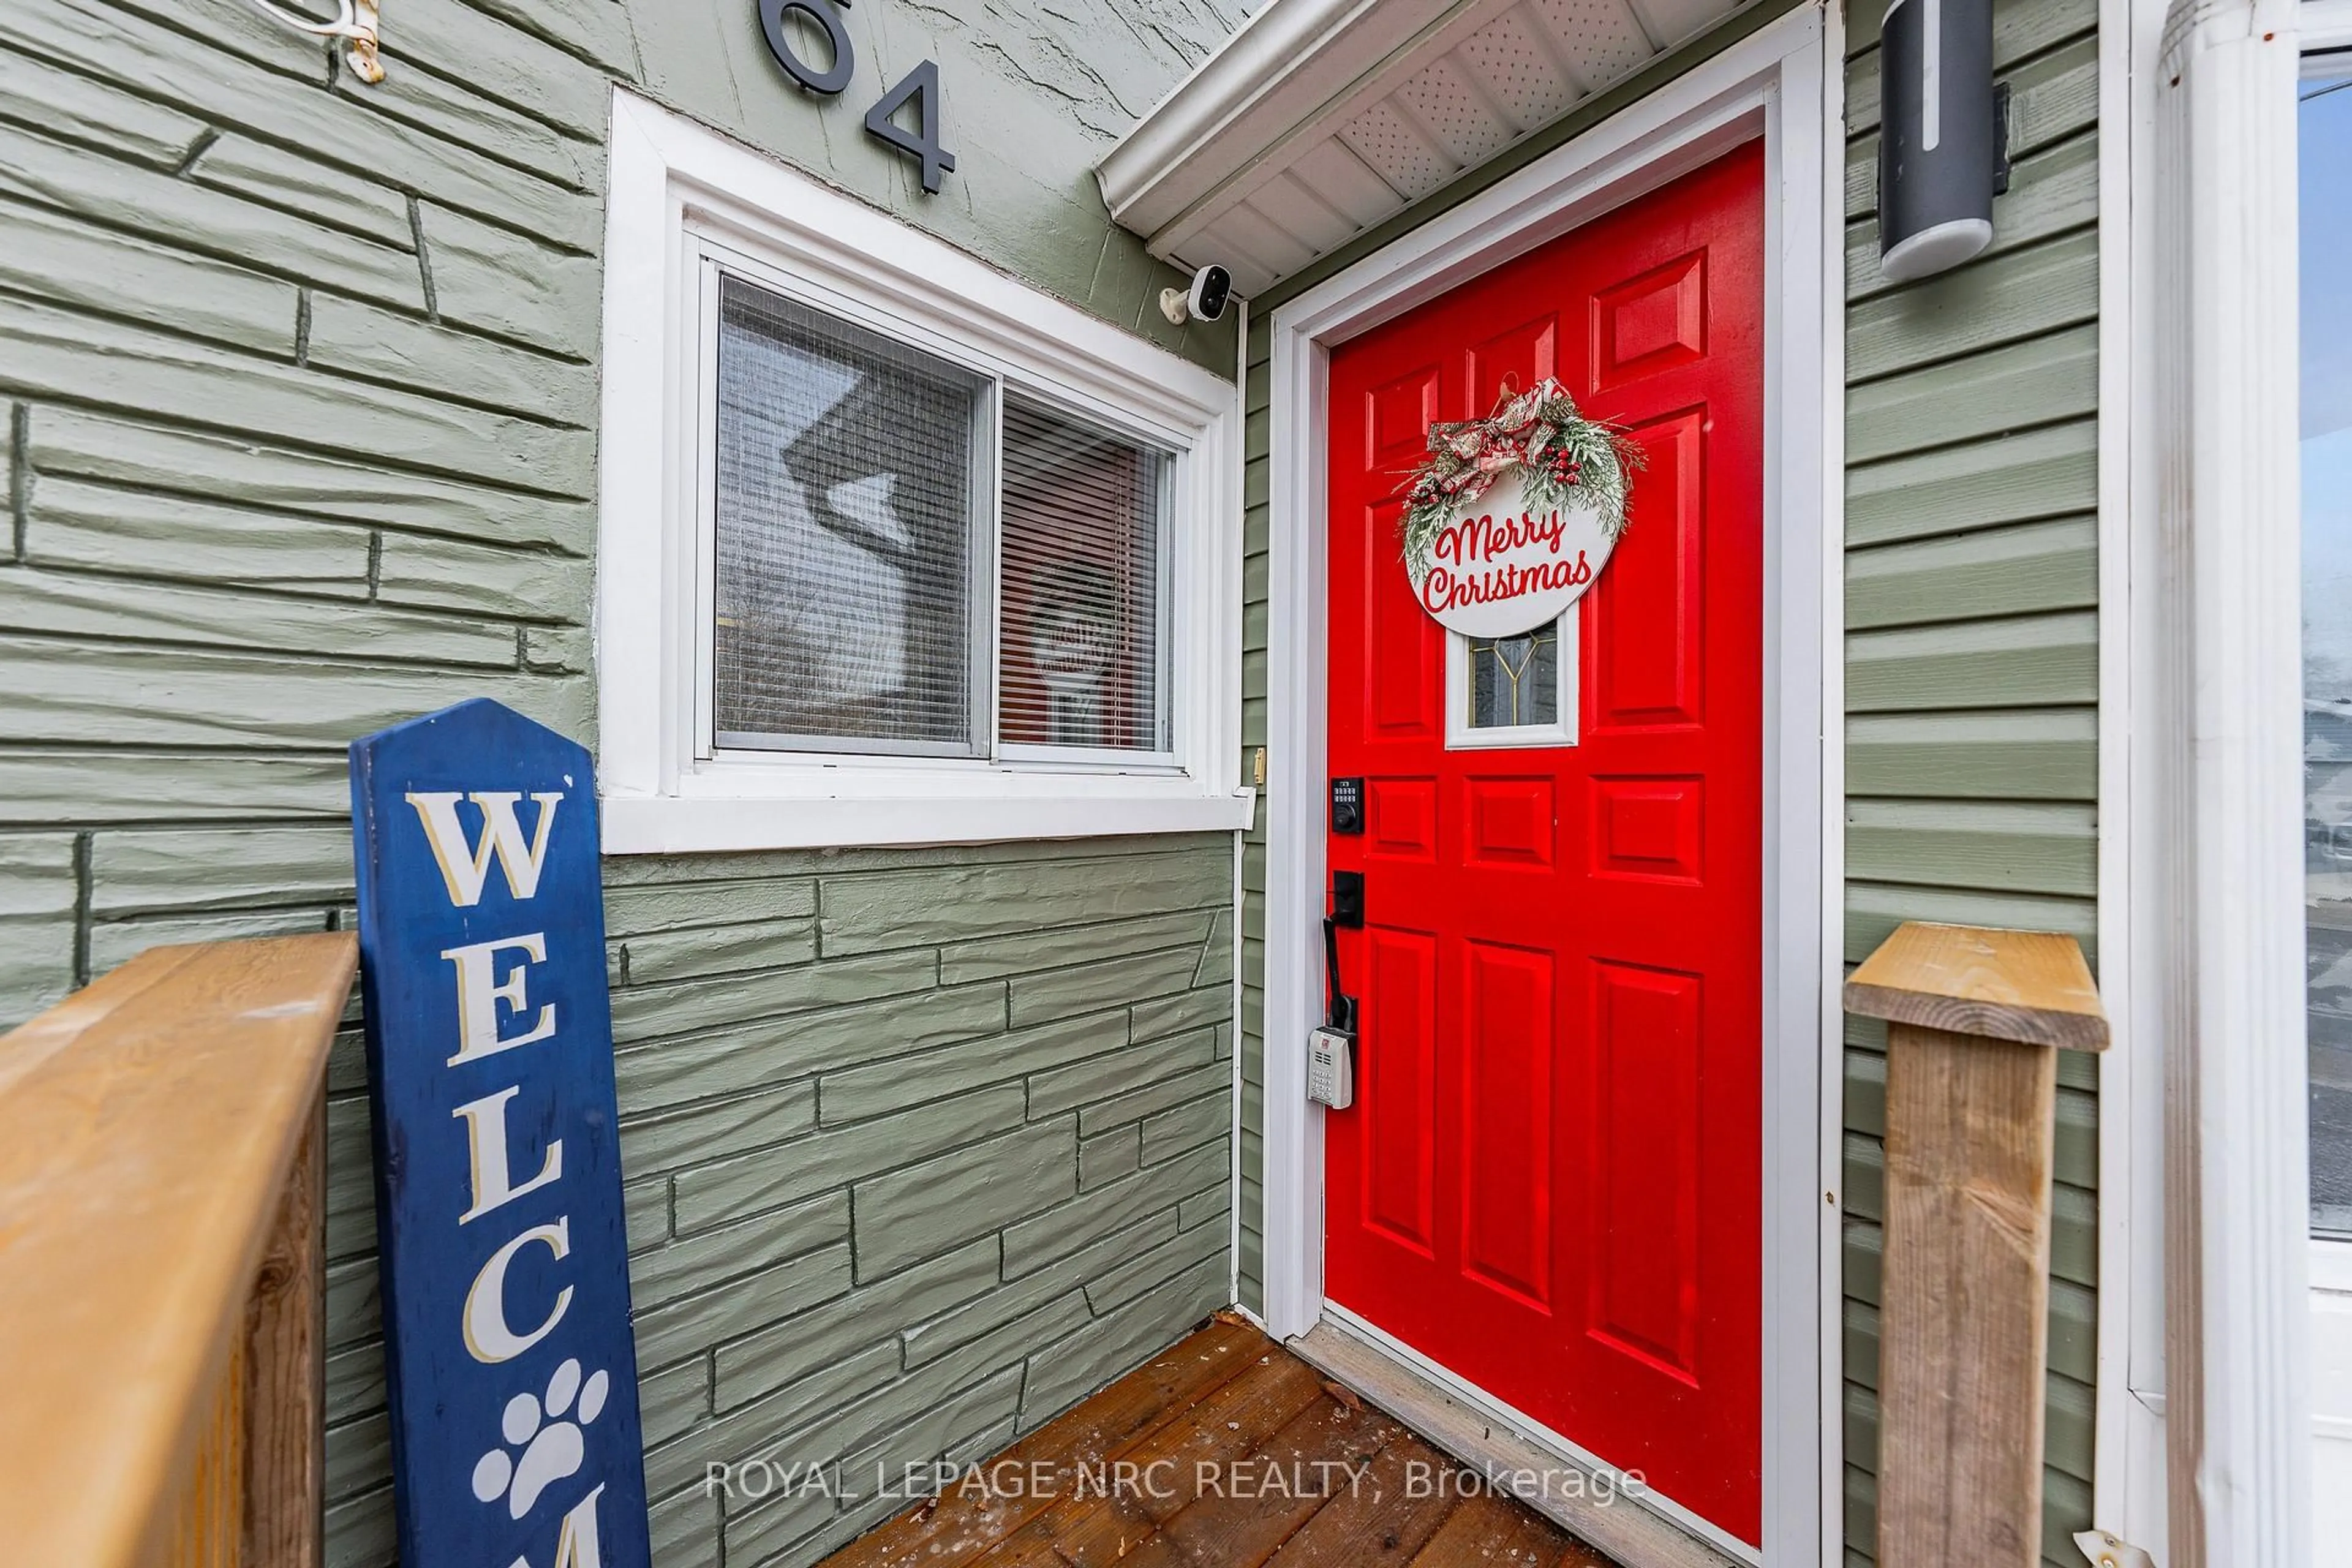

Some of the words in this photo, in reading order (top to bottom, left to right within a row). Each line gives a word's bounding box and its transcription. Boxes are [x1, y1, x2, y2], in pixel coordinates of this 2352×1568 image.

[758, 0, 956, 195] 64
[1434, 510, 1566, 566] Merry
[1423, 550, 1593, 613] Christmas
